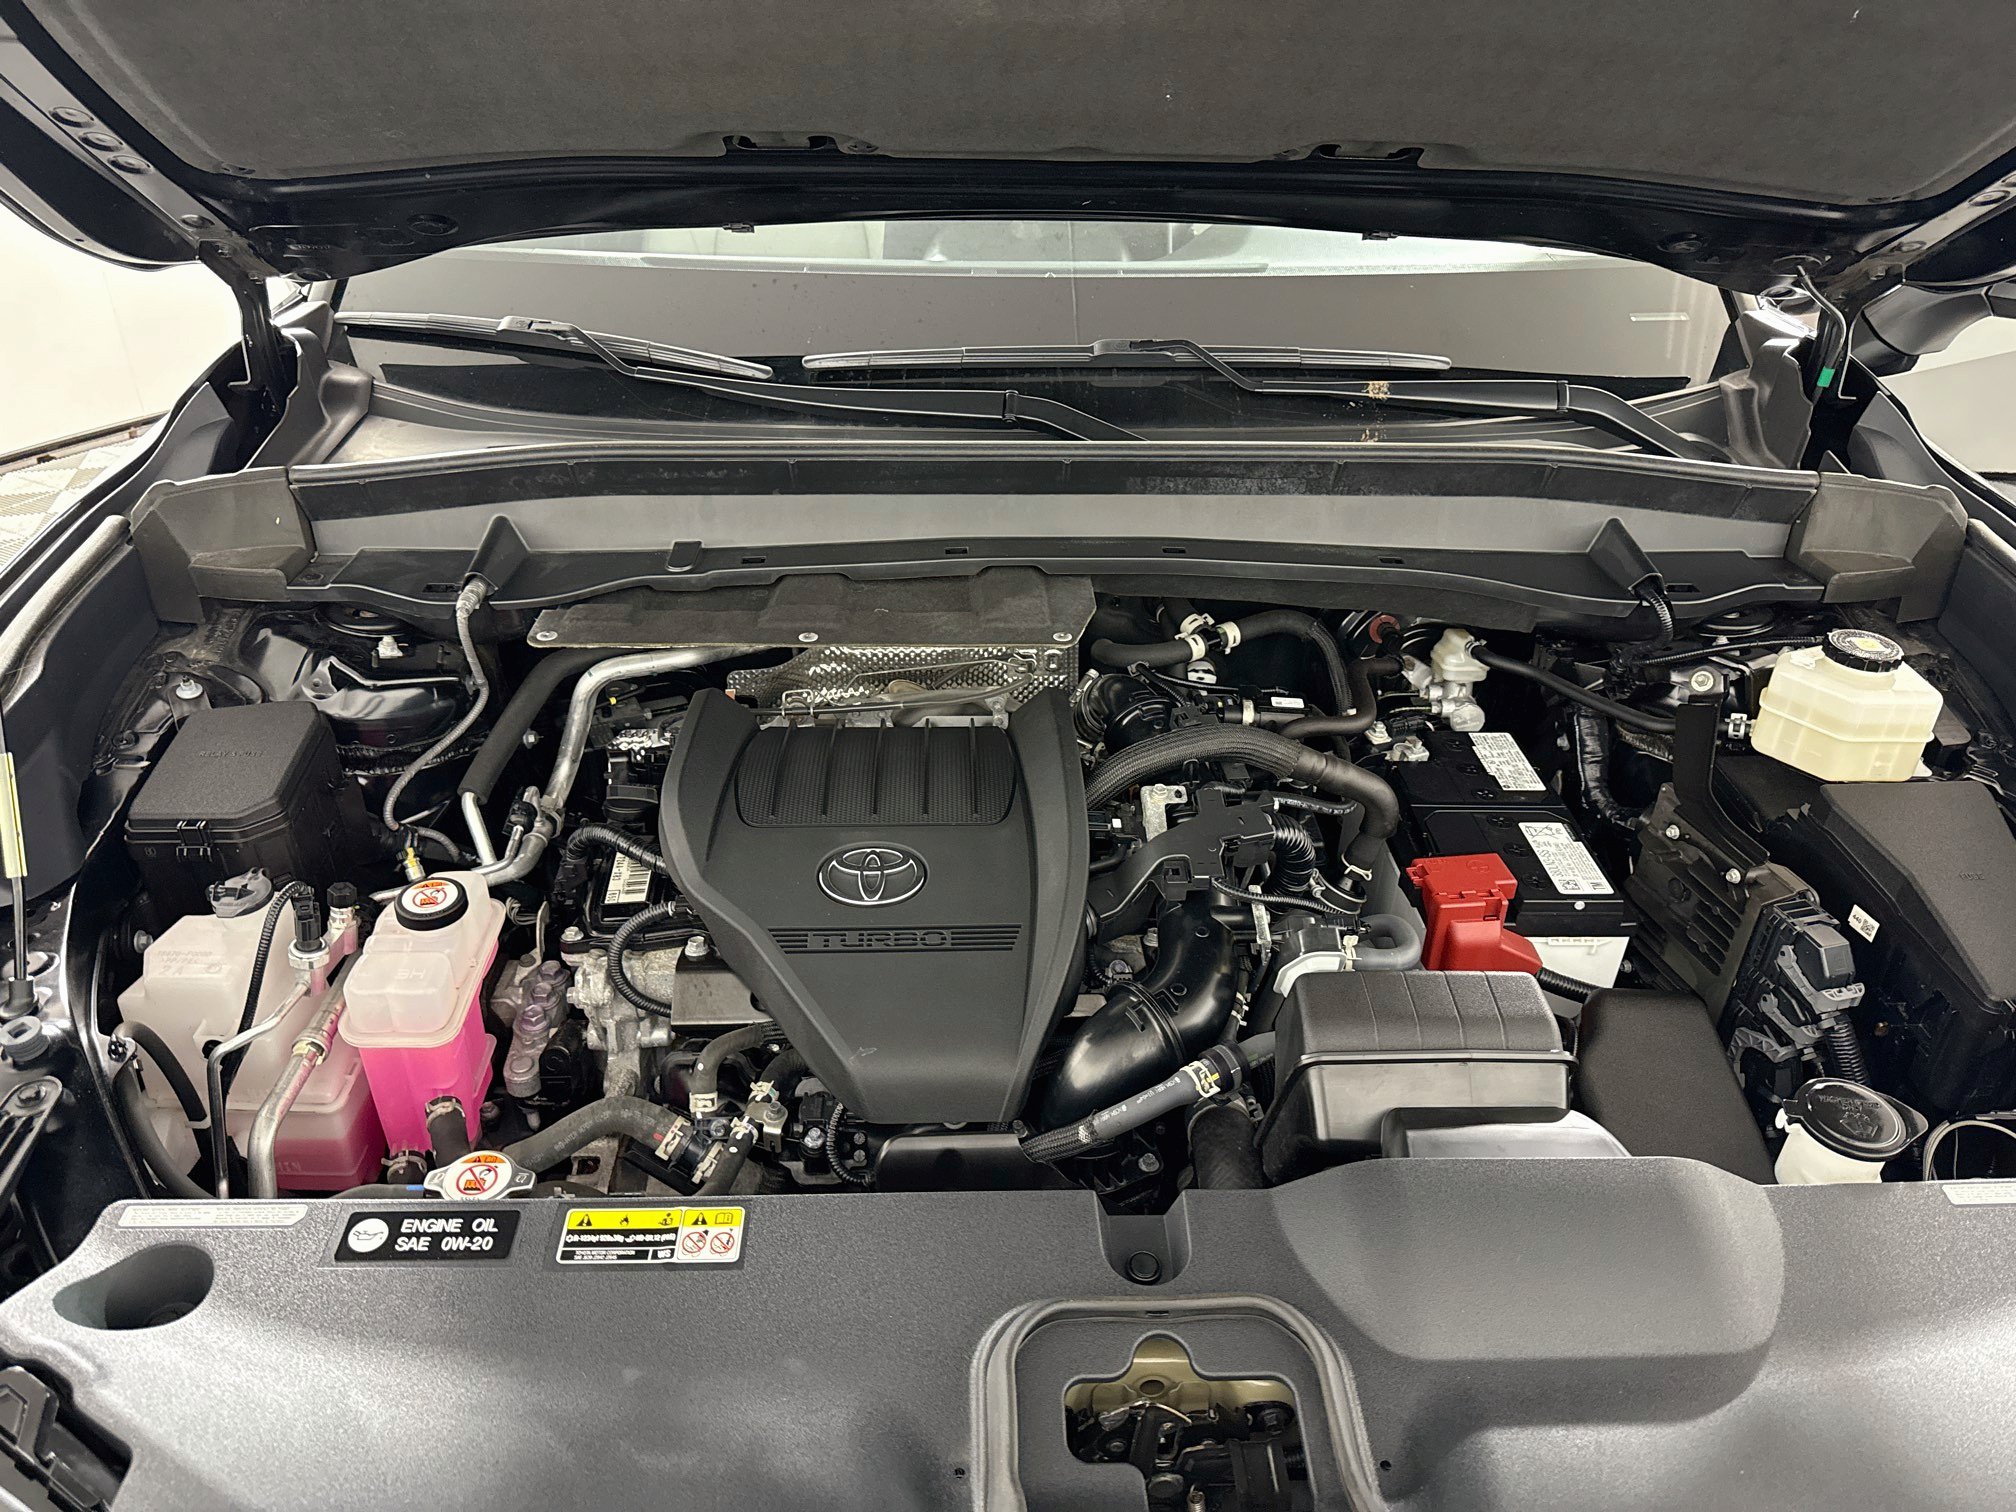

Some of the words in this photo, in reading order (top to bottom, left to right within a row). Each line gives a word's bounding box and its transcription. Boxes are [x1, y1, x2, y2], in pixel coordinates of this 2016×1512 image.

[1959, 872, 1985, 880] FUSE
[811, 929, 948, 948] TURBO
[400, 1218, 463, 1233] ENGINE
[471, 1217, 498, 1232] OIL
[394, 1236, 432, 1251] SAE
[440, 1236, 494, 1251] 0W-20
